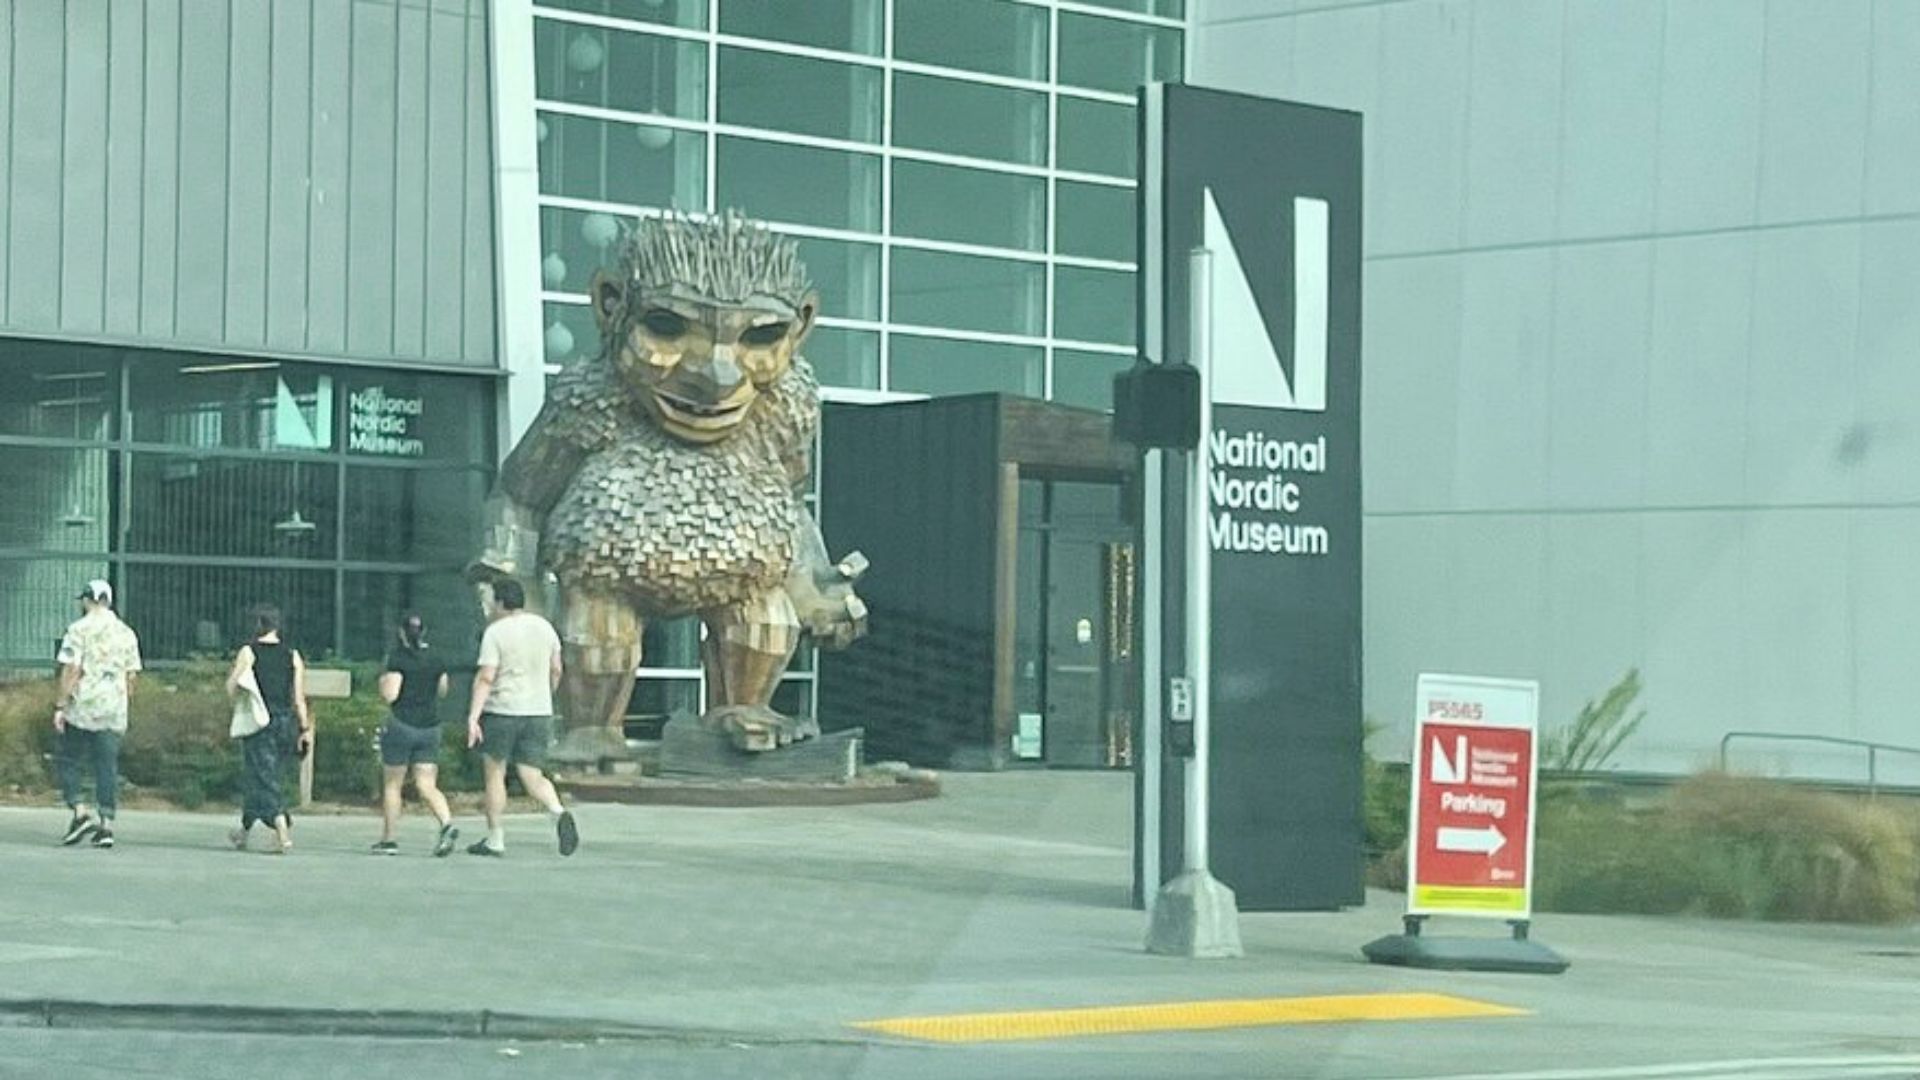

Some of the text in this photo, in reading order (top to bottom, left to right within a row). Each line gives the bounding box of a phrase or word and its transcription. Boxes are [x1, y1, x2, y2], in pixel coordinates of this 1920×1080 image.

[1204, 186, 1329, 411] N
[276, 374, 333, 449] N
[350, 432, 423, 456] Museum
[1208, 429, 1326, 472] National
[1209, 470, 1300, 512] Nordic
[1208, 511, 1329, 554] Museum
[1431, 735, 1468, 784] N
[1441, 791, 1506, 819] Parking
